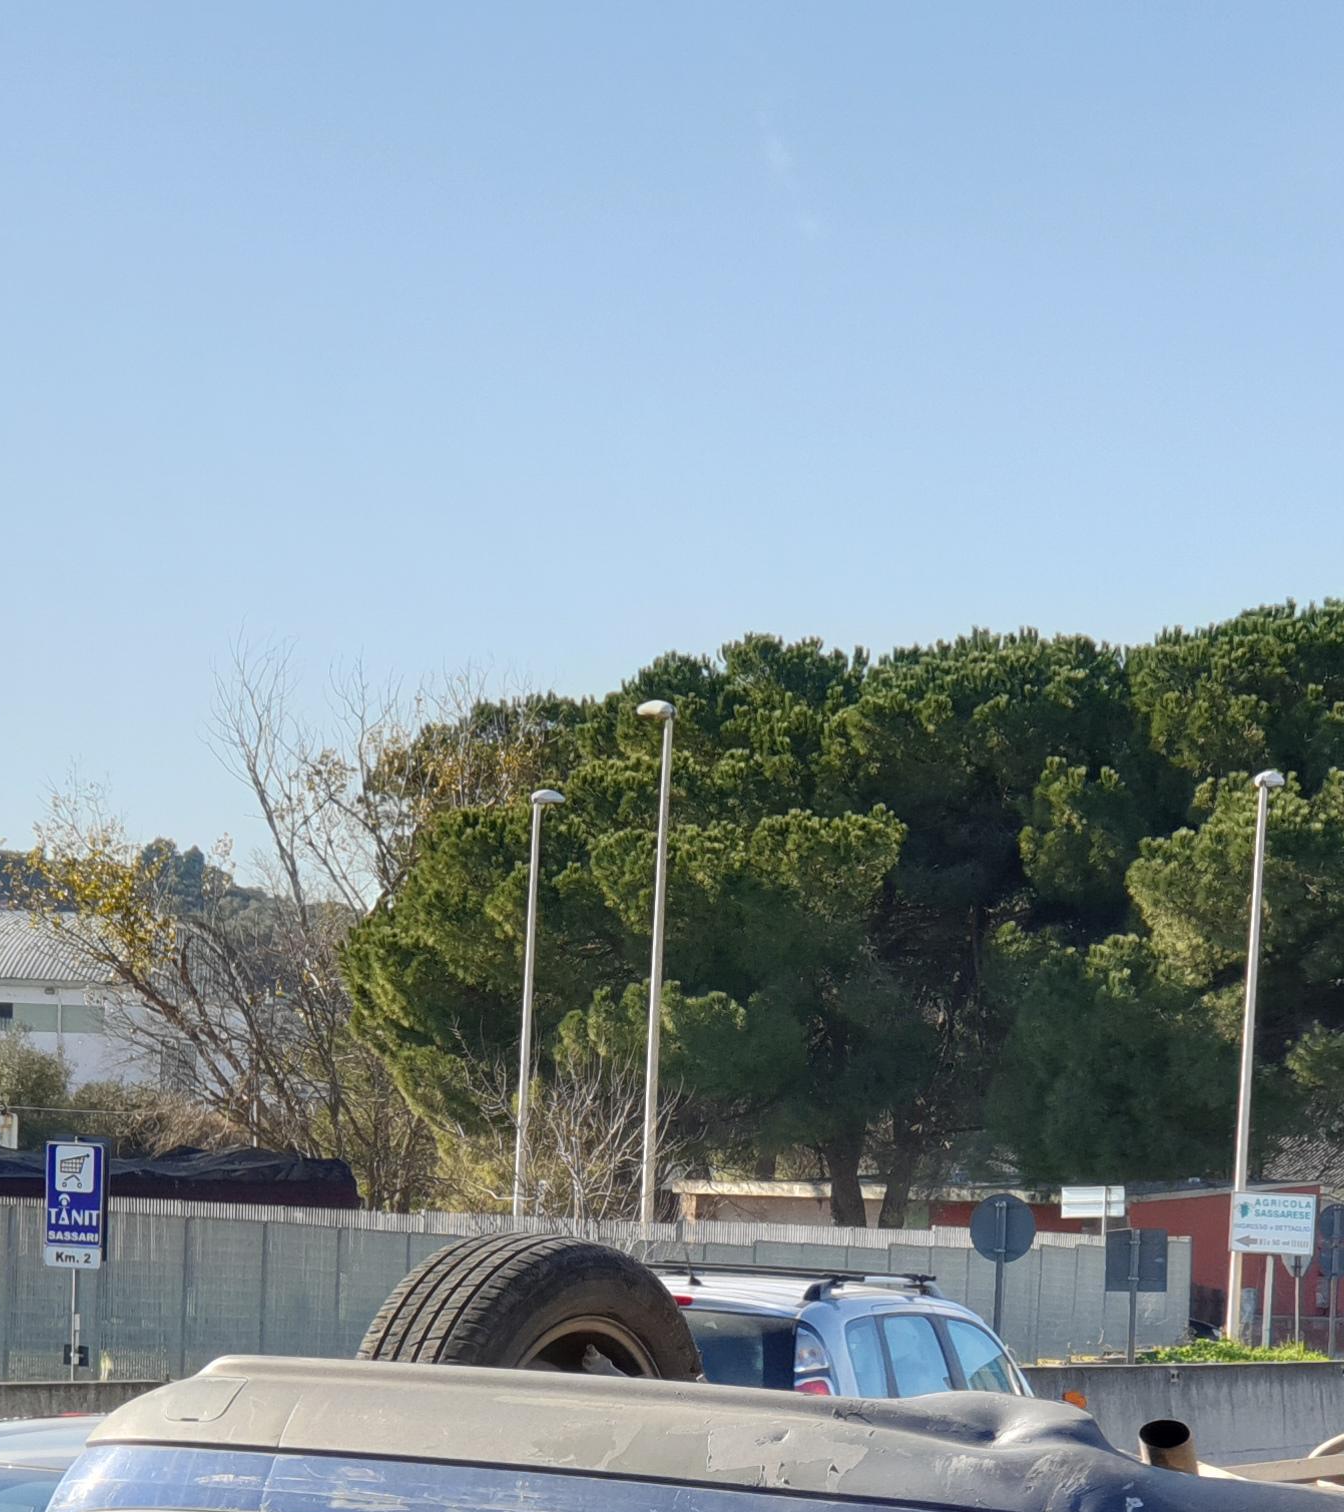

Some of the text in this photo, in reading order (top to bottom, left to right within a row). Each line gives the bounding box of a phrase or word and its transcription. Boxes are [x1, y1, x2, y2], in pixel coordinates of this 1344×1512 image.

[1254, 1198, 1312, 1209] AGRICOLA
[48, 1205, 100, 1226] TANIT
[1254, 1209, 1312, 1220] SASSARESE
[48, 1230, 99, 1242] SASSARI
[55, 1251, 92, 1264] Km. 2
